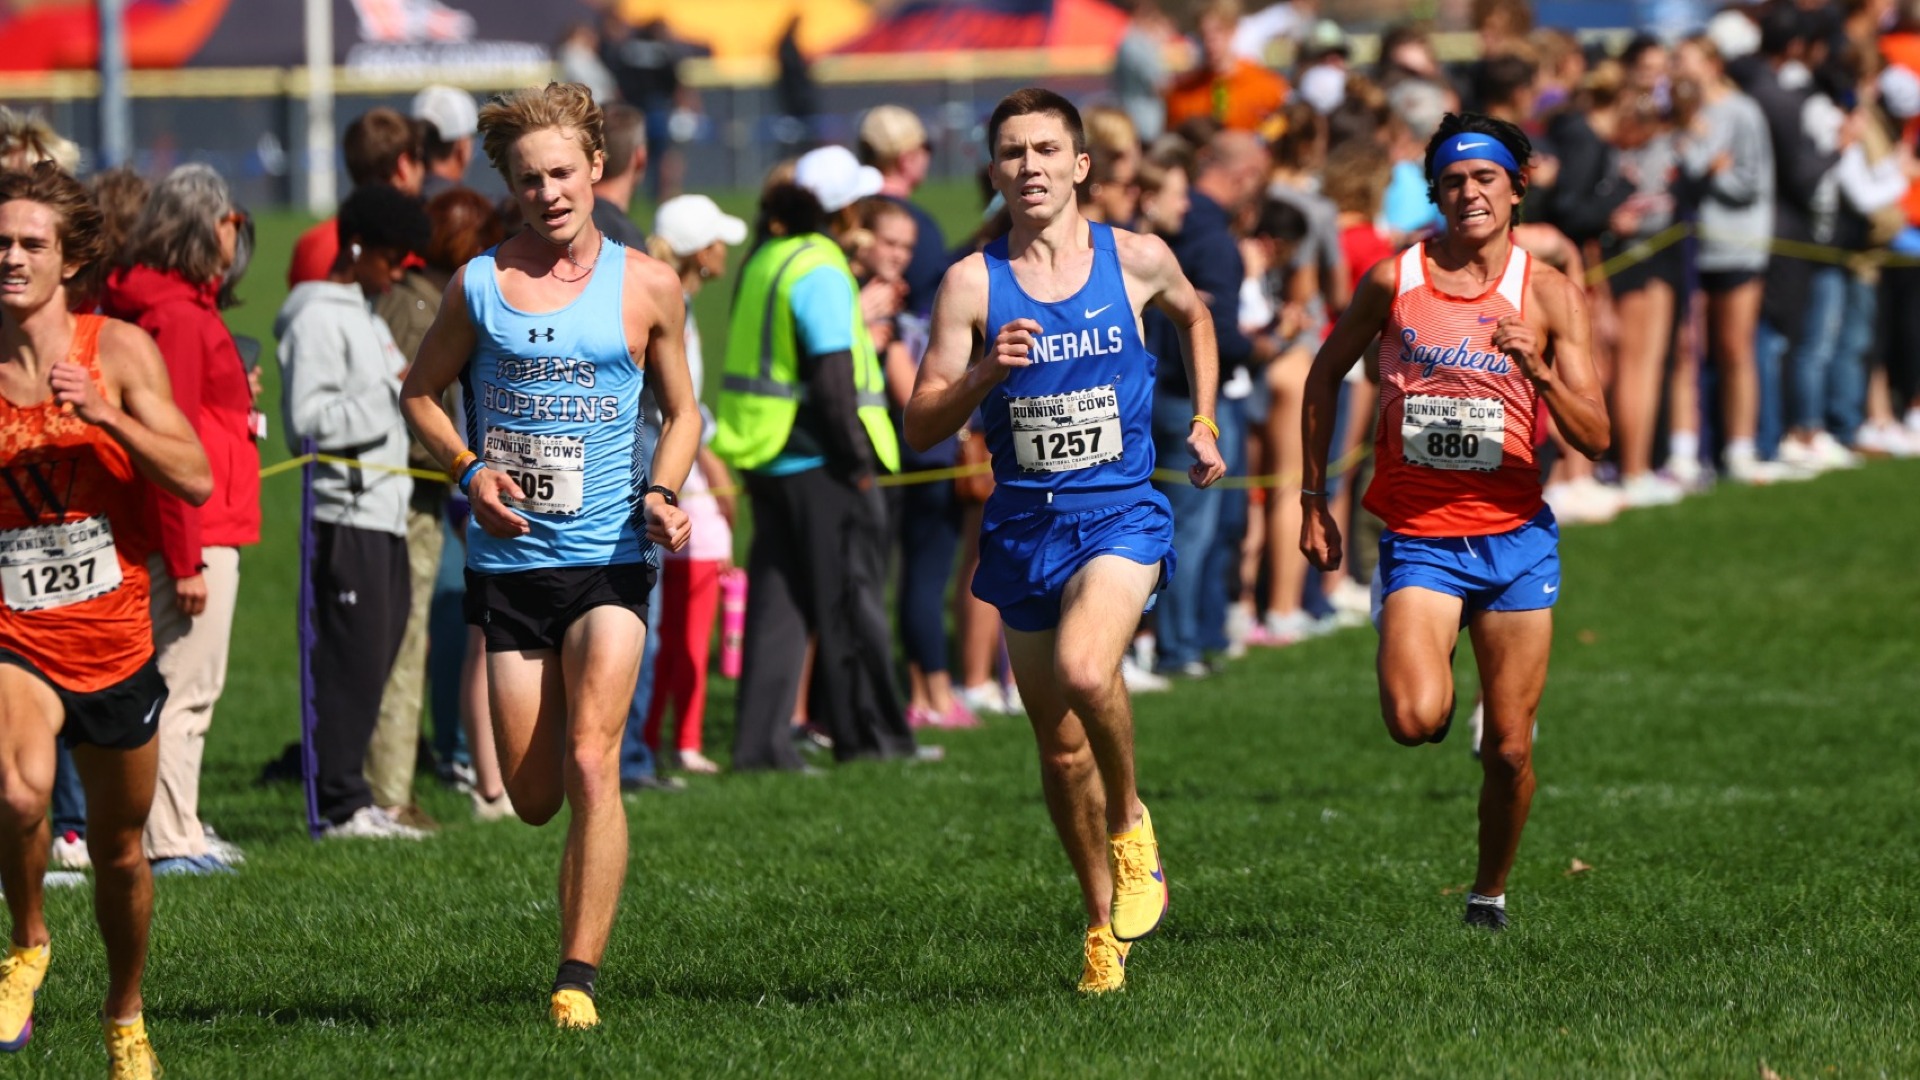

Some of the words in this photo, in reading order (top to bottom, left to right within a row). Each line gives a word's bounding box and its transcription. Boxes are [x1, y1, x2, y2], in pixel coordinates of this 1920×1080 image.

[1026, 325, 1123, 364] NERALS
[1399, 327, 1512, 378] Sagehens
[496, 356, 596, 388] JOHNS
[482, 381, 619, 422] HOPKINS
[1012, 404, 1065, 418] RUNNING
[1078, 395, 1115, 412] COWS
[1406, 404, 1457, 417] RUNNING
[1469, 407, 1503, 419] COWS
[486, 436, 531, 455] RUNNING
[543, 445, 583, 459] COWS
[1031, 427, 1102, 460] 1257
[1427, 432, 1479, 458] 880
[0, 458, 80, 523] W
[68, 522, 109, 546] COWS
[21, 557, 97, 596] 1237
